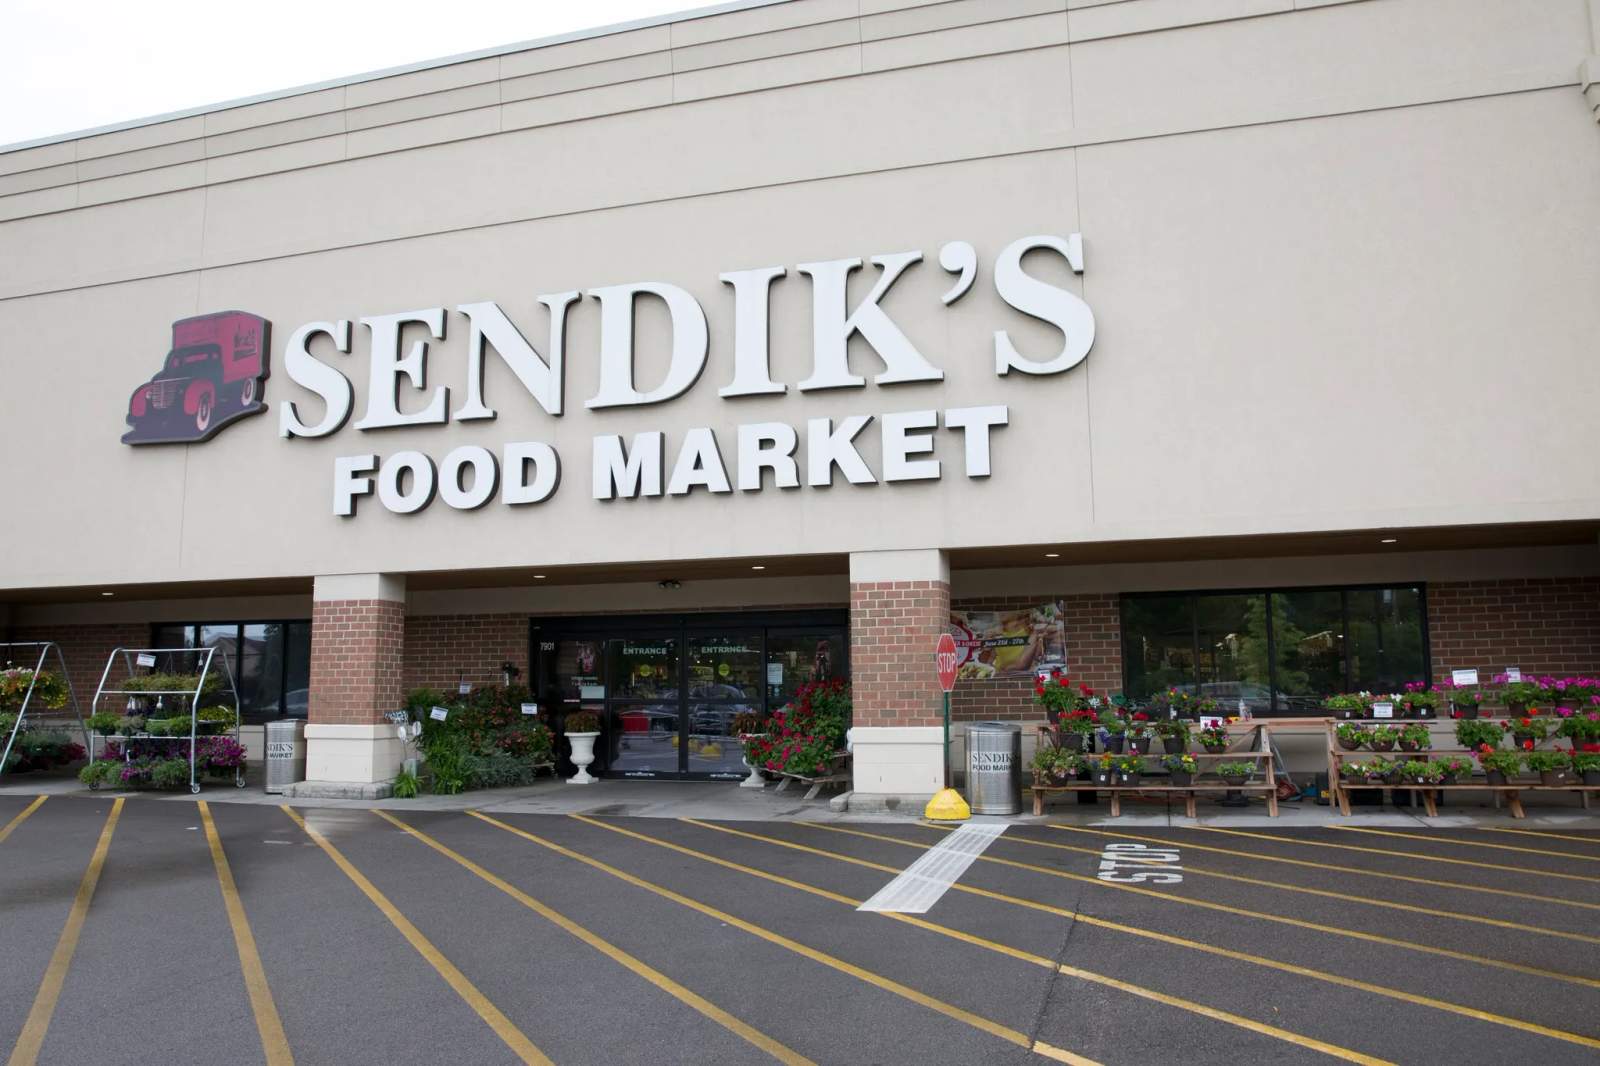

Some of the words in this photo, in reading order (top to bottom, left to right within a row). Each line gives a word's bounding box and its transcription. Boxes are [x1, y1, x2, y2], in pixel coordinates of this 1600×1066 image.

[279, 232, 1096, 439] SENDIK'S
[333, 442, 562, 517] FOOD
[592, 405, 1010, 501] MARKET
[623, 647, 667, 655] ENTRANCE
[701, 645, 746, 654] ENTRANCE
[938, 652, 956, 673] STOP
[1097, 843, 1184, 884] STOP
